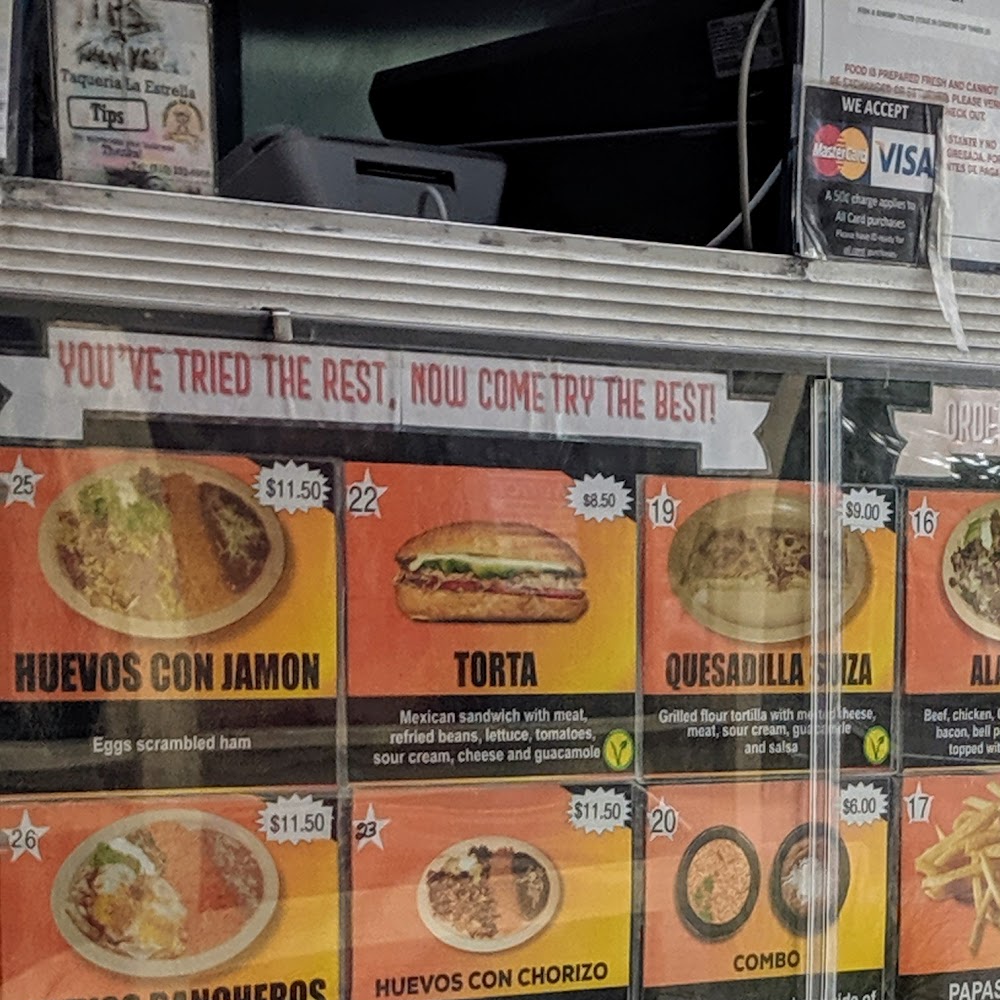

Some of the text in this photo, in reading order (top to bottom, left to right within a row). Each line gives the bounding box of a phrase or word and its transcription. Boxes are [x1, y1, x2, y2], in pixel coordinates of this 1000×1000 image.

[60, 69, 195, 99] Taqueria La Estrella
[90, 103, 124, 129] Tips
[842, 96, 909, 119] WE ACCEPT
[812, 143, 867, 164] MasterCard
[876, 141, 936, 179] VISA
[58, 340, 716, 424] YOU'VE TRIED THE REST, NOW COME TRY THE BEST!
[13, 476, 34, 495] 25
[265, 480, 321, 500] $11.50
[349, 486, 377, 513] 22
[583, 492, 615, 508] $8.50
[650, 500, 674, 524] 19
[846, 502, 879, 521] $9.00
[913, 511, 934, 534] 16
[15, 652, 320, 693] HUEVOS CON JAMON
[454, 651, 538, 687] TORTA
[666, 653, 804, 690] QUESADILLA
[92, 734, 251, 755] Eggs scrambled ham
[574, 802, 621, 821] $11.50
[843, 798, 876, 815] $6.00
[909, 797, 929, 819] 17
[270, 815, 325, 834] $11.50
[355, 821, 377, 840] 23
[651, 809, 675, 834] 20
[11, 830, 36, 850] 26
[733, 950, 800, 971] COMBO
[376, 962, 608, 998] HUEVOS CON CHORIZO
